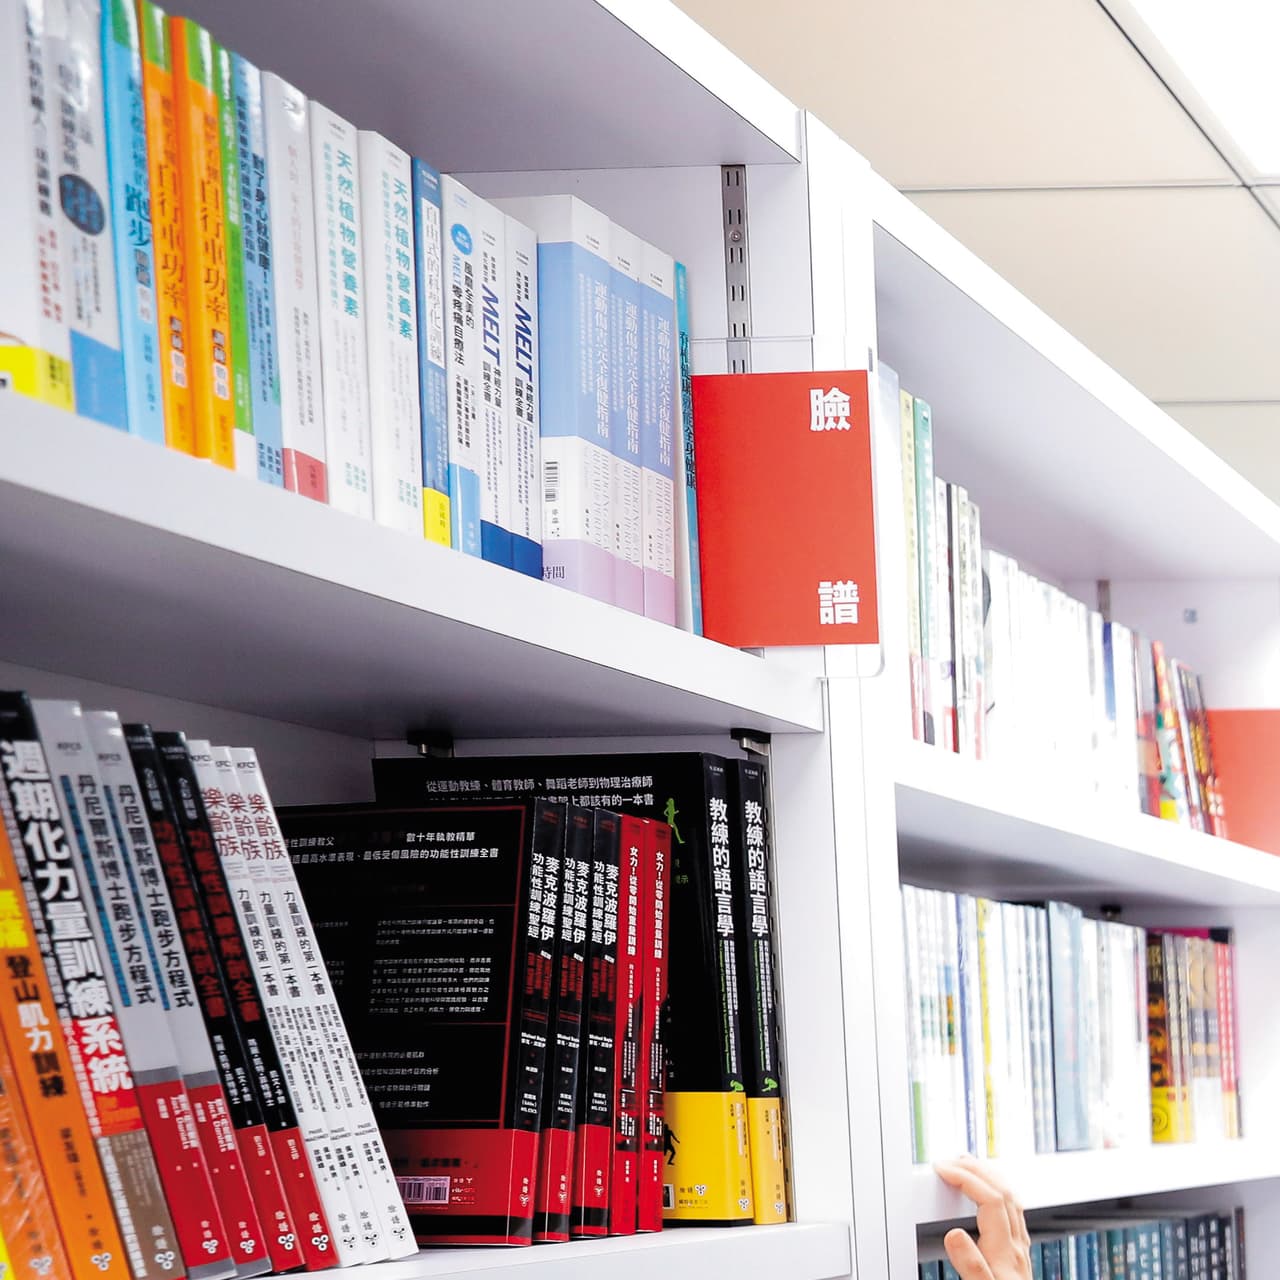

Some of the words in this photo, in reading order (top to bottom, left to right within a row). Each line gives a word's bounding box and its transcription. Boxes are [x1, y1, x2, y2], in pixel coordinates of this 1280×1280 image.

[337, 149, 359, 319] 天然植物營養素
[393, 176, 412, 341] 天然植物營養素
[482, 283, 501, 367] MELT
[514, 301, 533, 382] MELT
[809, 387, 860, 626] 臉譜
[426, 775, 654, 794] 從運動教練、體育教師、舞蹈老師到物理治療師
[3, 740, 134, 1097] 週期化力量訓練系統
[78, 774, 156, 1007] 丹尼爾斯博士跑步方程式
[117, 784, 195, 1010] 丹尼爾斯博士跑步方程式
[527, 852, 546, 938] 功能性訓練聖經
[540, 856, 560, 941] 麥克波羅伊
[560, 857, 577, 941] 功能性訓練聖經
[573, 860, 590, 943] 麥克波羅伊
[591, 860, 606, 944] 功能性訓練聖經
[603, 863, 618, 945] 麥克波羅伊
[709, 797, 735, 938] 教練的語言學
[744, 800, 769, 937] 教練的語言學
[236, 887, 279, 999] 力量訓練的第一本書
[259, 890, 302, 1001] 力量訓練的第一本書
[283, 891, 328, 998] 力量訓練的第一本書
